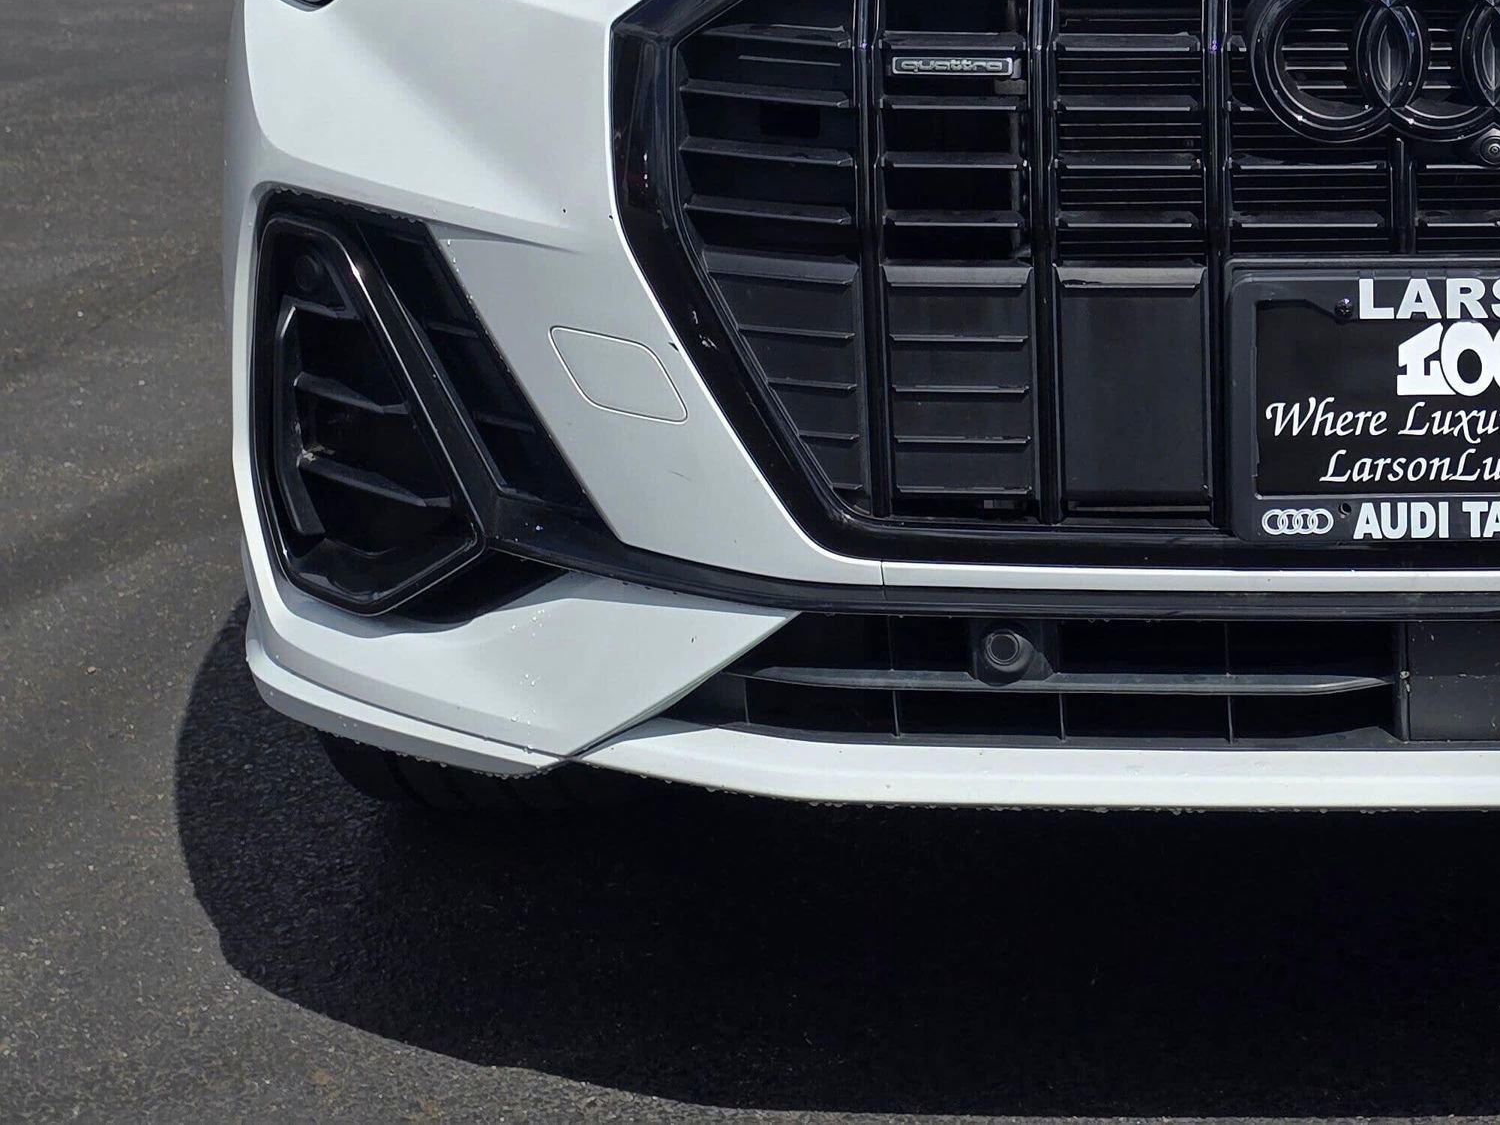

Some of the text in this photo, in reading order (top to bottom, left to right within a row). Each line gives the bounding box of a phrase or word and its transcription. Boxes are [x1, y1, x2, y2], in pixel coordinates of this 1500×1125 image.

[901, 59, 1003, 73] quattro
[1265, 396, 1389, 438] Where
[1353, 501, 1450, 539] AUDI
